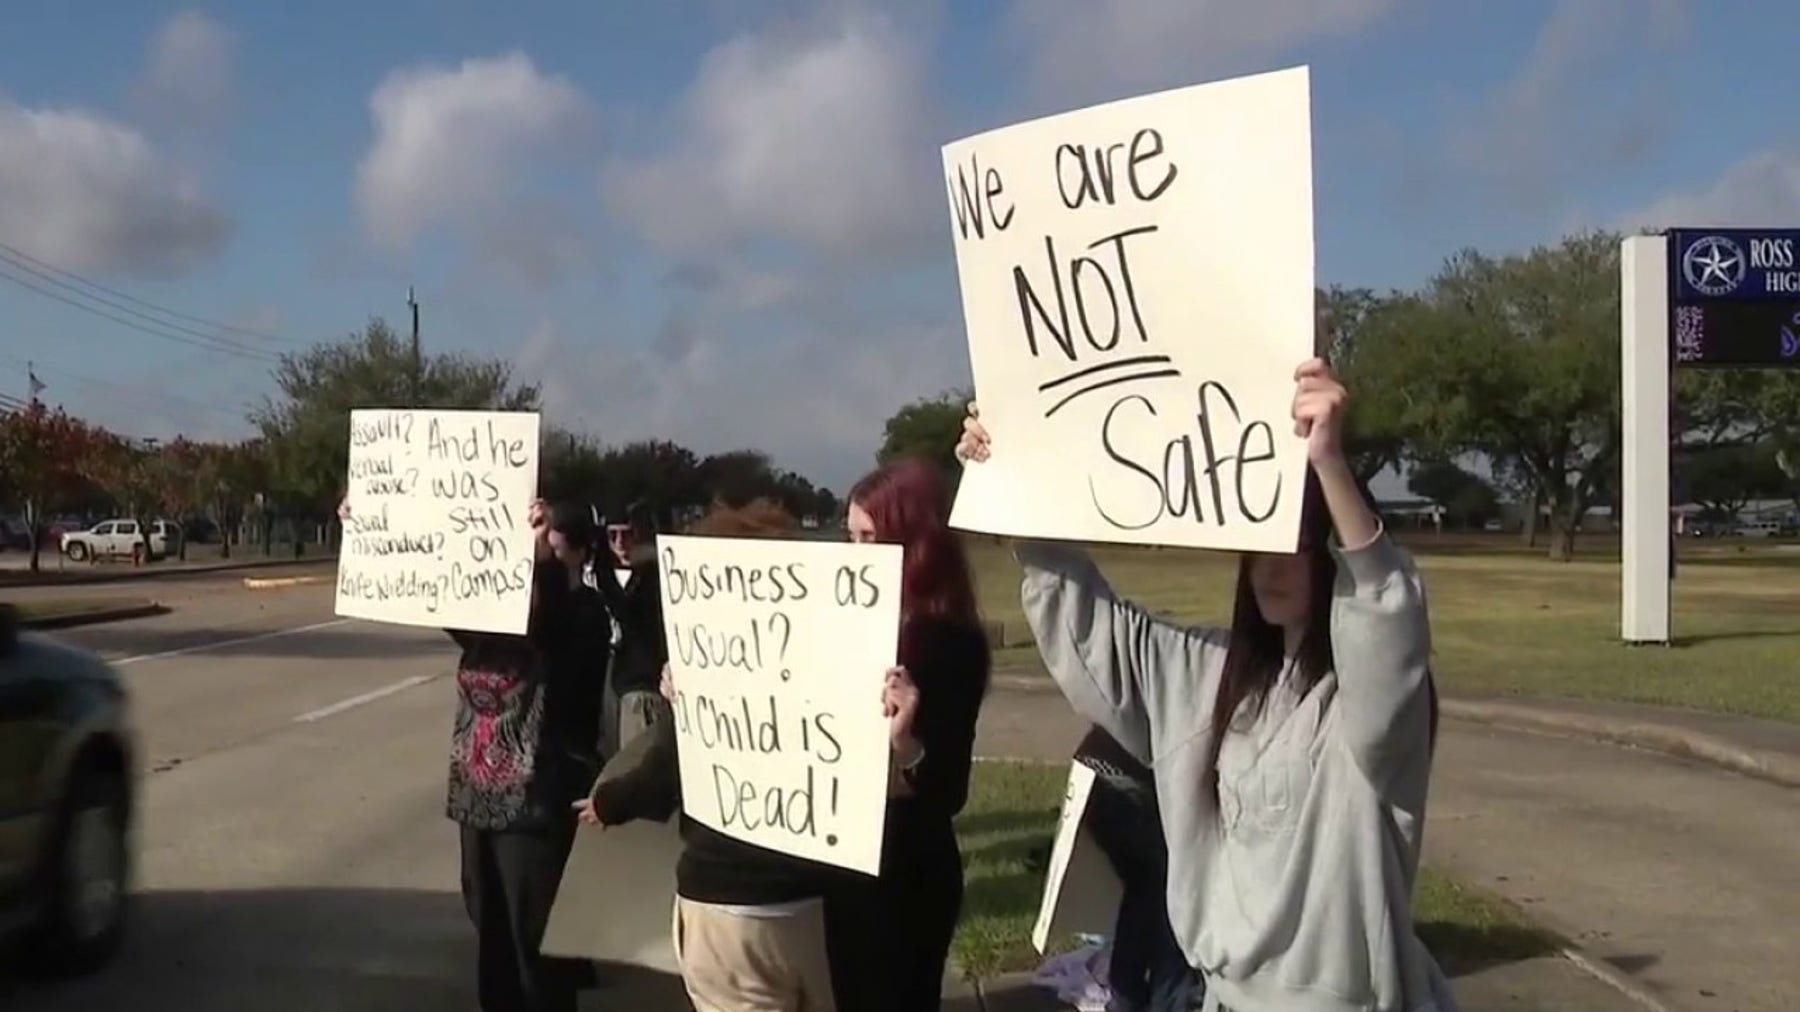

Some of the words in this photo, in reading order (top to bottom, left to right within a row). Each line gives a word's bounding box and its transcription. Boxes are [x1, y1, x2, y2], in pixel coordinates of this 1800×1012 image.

[950, 154, 1015, 240] We
[1056, 129, 1178, 209] are
[1750, 239, 1793, 268] ROSS
[1766, 271, 1800, 292] HIG
[1013, 226, 1158, 361] NOT
[428, 416, 479, 463] And
[488, 419, 528, 468] he
[1088, 381, 1282, 530] Safe
[432, 470, 499, 502] was
[470, 536, 507, 562] on
[662, 546, 808, 605] Business
[834, 563, 880, 608] as
[801, 699, 842, 764] is
[712, 763, 838, 847] Dead!
